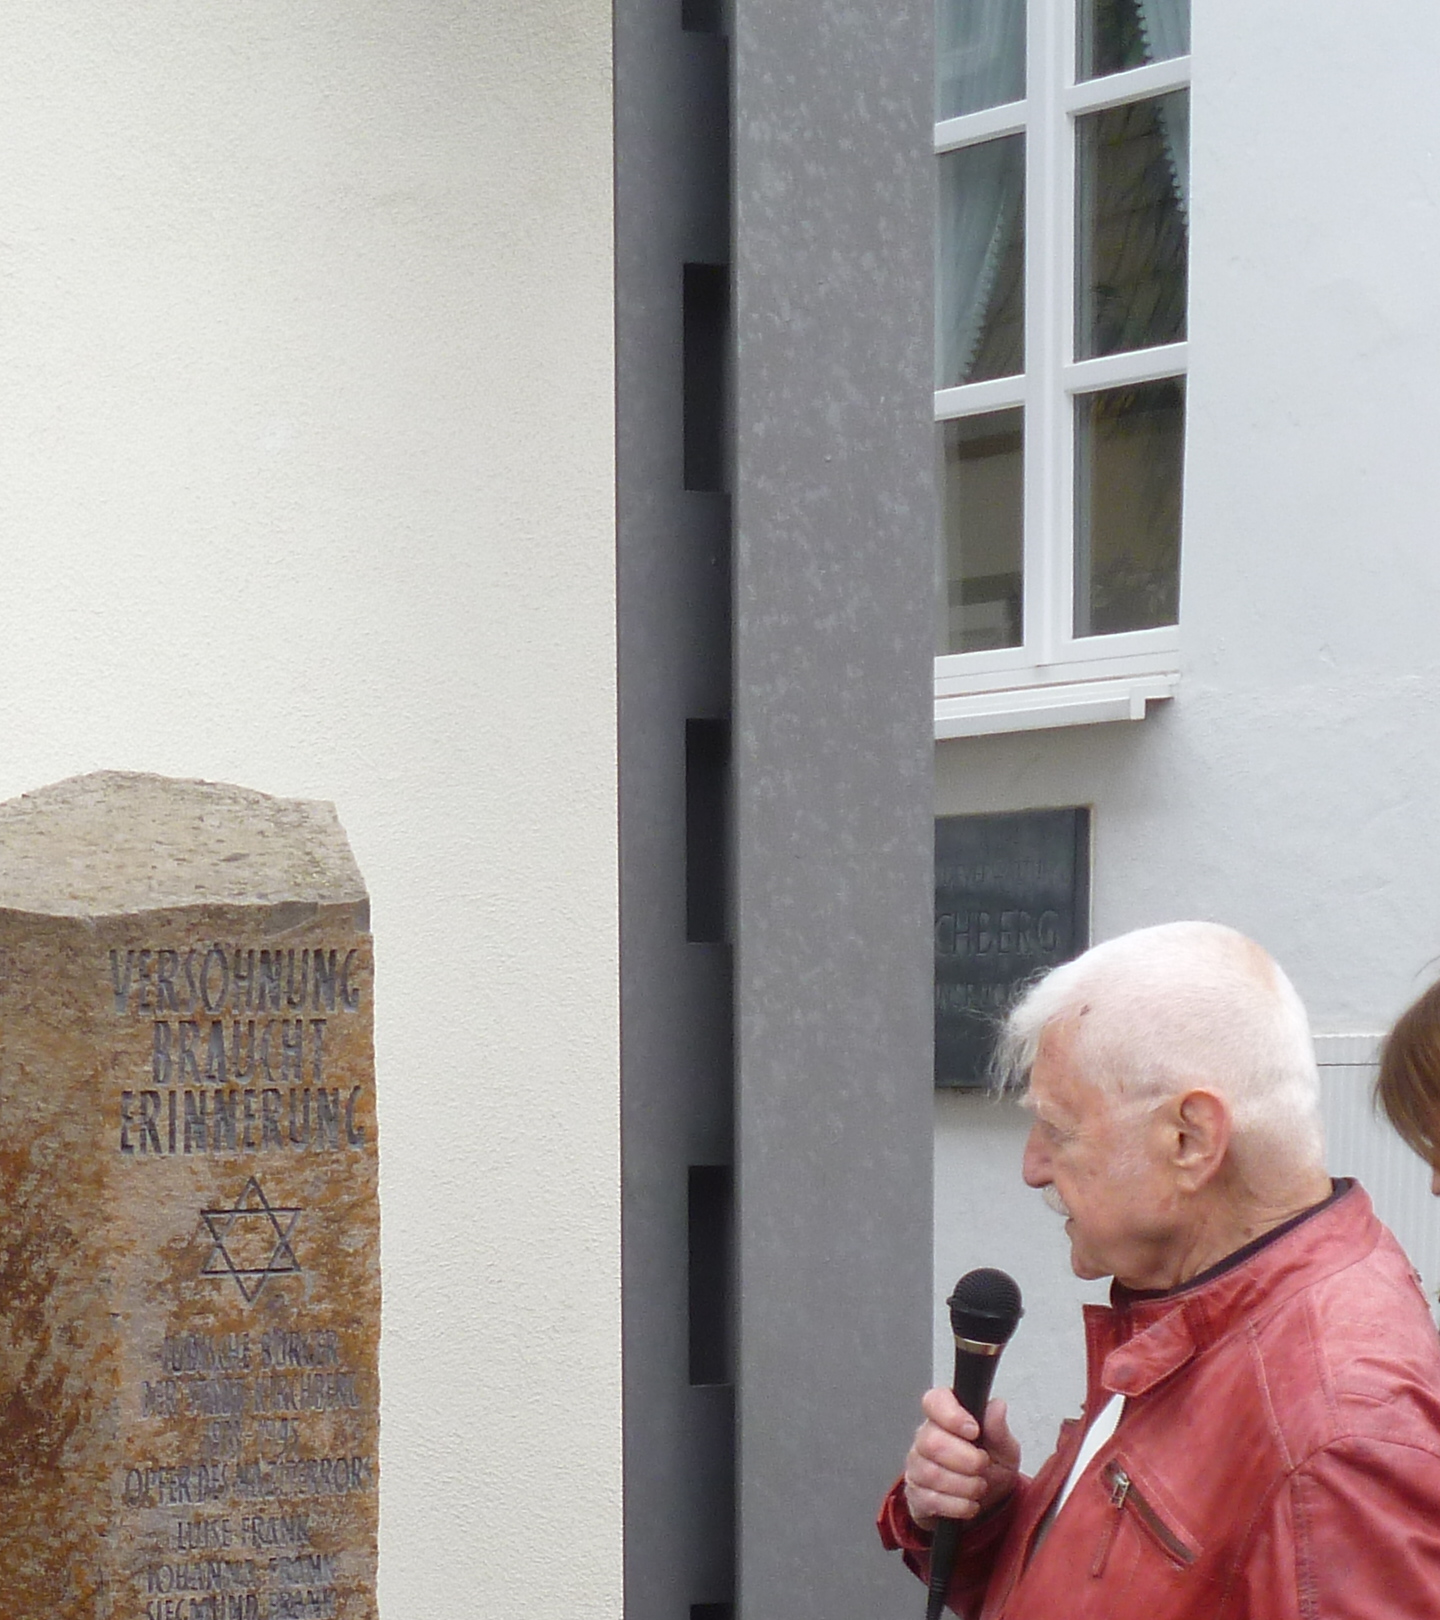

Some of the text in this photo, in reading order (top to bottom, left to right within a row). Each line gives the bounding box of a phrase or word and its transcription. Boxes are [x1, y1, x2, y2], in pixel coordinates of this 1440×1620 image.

[110, 942, 360, 1014] VERSÖHNUNG
[153, 1018, 327, 1085] BRAUCHT
[120, 1085, 365, 1154] ERINNERUNG
[142, 1380, 177, 1418] DER
[254, 1371, 359, 1413] KIRCHBERG
[124, 1464, 191, 1506] OPFER
[198, 1461, 228, 1502] DES
[178, 1515, 310, 1551] LUISE FRANK
[147, 1553, 336, 1594] JOHANNA FRANK
